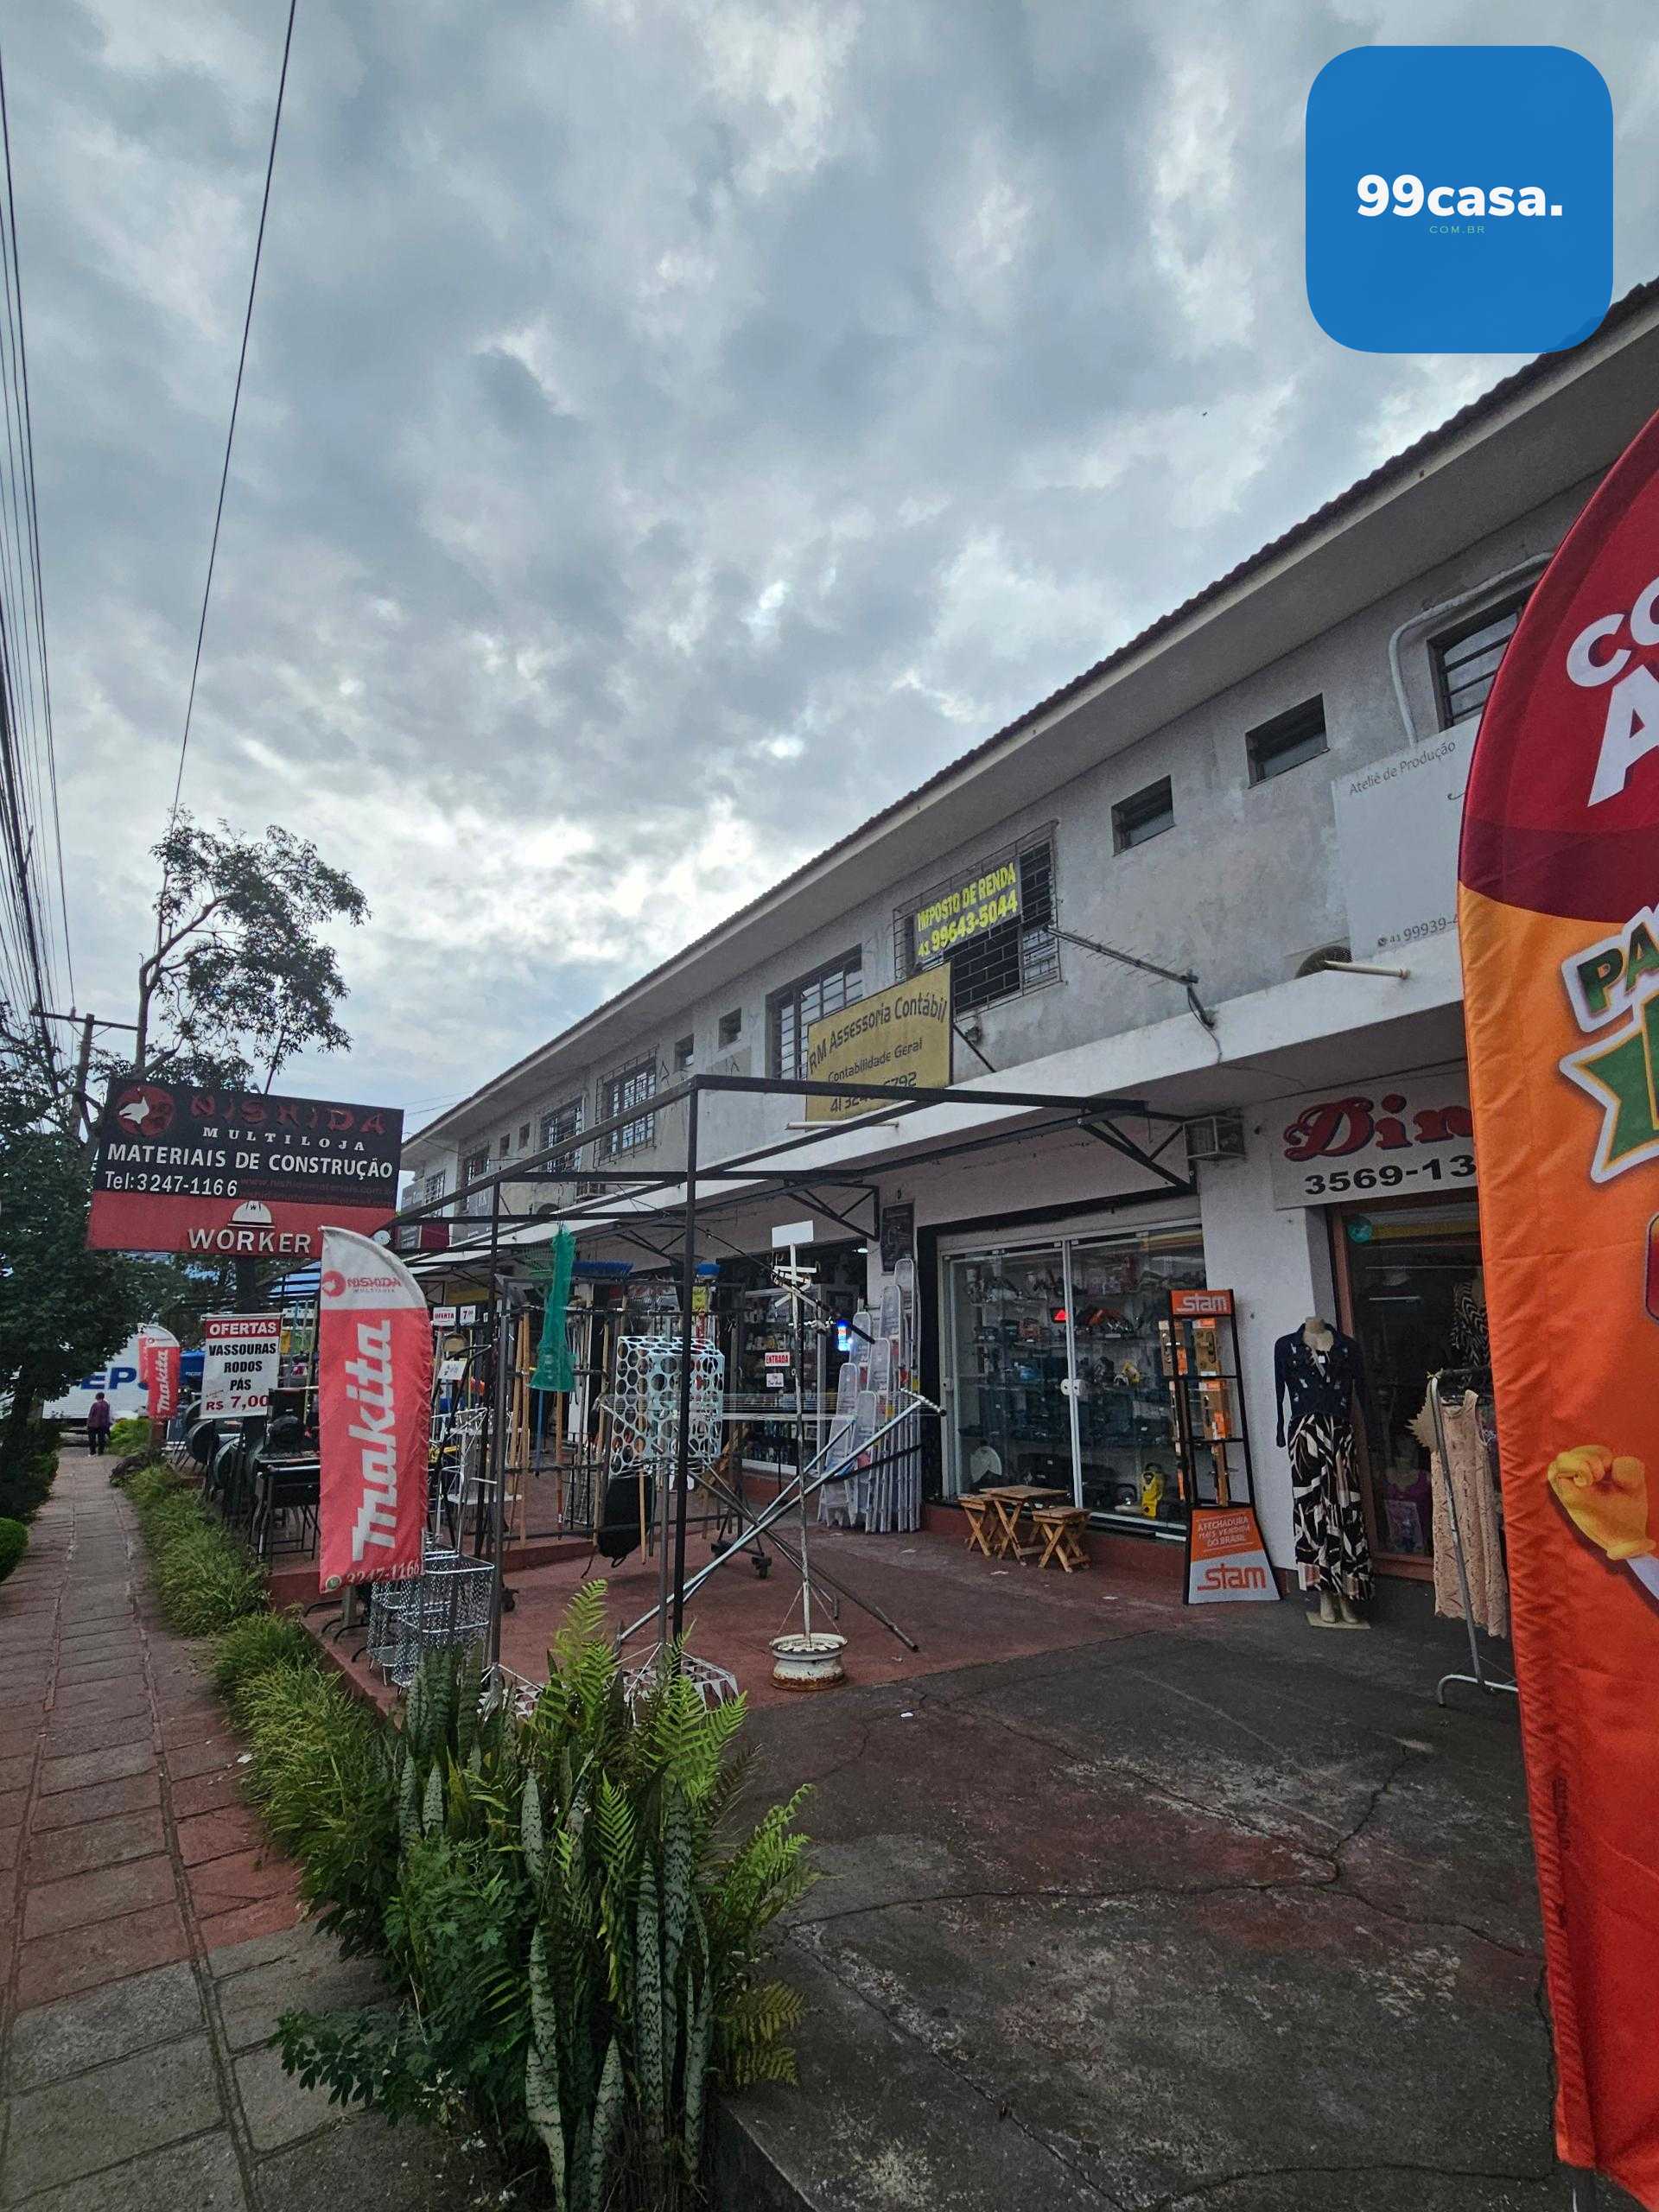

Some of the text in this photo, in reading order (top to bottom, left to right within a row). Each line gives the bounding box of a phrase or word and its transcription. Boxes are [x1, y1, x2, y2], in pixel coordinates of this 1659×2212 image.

[1384, 767, 1397, 780] de
[1400, 741, 1455, 772] Produção
[918, 862, 1015, 931] IMPOSTO DE RENDA
[809, 992, 947, 1075] RM Assessoria Contábil
[829, 1038, 923, 1082] Contabilidade Geral
[203, 1127, 364, 1151] MULTILOJA
[107, 1143, 392, 1179] MATERIAIS DE CONSTRUÇÃO
[188, 1228, 311, 1253] WORKER
[209, 1322, 276, 1335] OFERTAS
[208, 1343, 276, 1356] VASSOURAS
[766, 1355, 788, 1363] ENTRADA
[224, 1361, 263, 1373] RODOS
[230, 1377, 251, 1390] PÁS
[346, 1319, 397, 1561] makita
